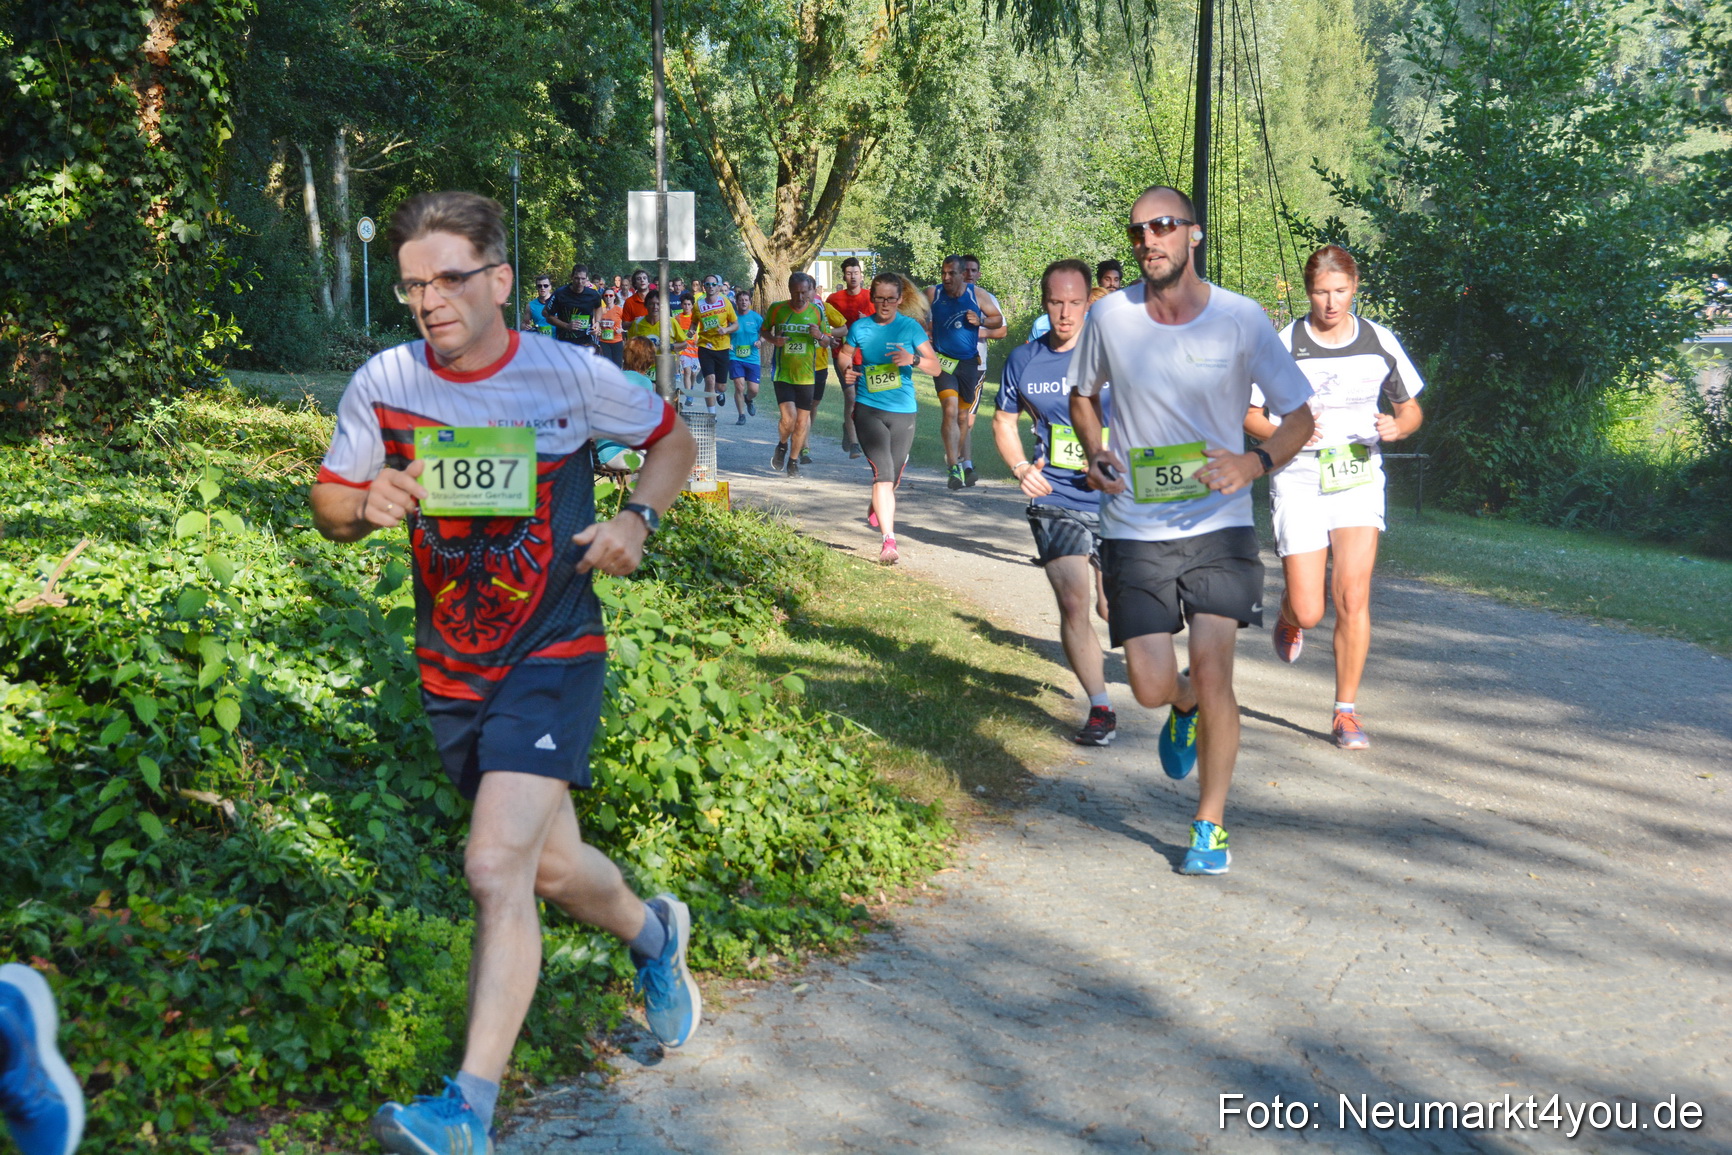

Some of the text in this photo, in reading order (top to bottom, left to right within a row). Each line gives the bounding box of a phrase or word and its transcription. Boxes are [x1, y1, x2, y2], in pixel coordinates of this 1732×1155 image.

[788, 342, 803, 351] 223
[869, 372, 896, 385] 1526
[487, 418, 556, 429] NEUMARKT
[432, 459, 519, 489] 1887
[1327, 457, 1366, 478] 1457
[1155, 465, 1183, 486] 58
[484, 491, 523, 500] Gerhard
